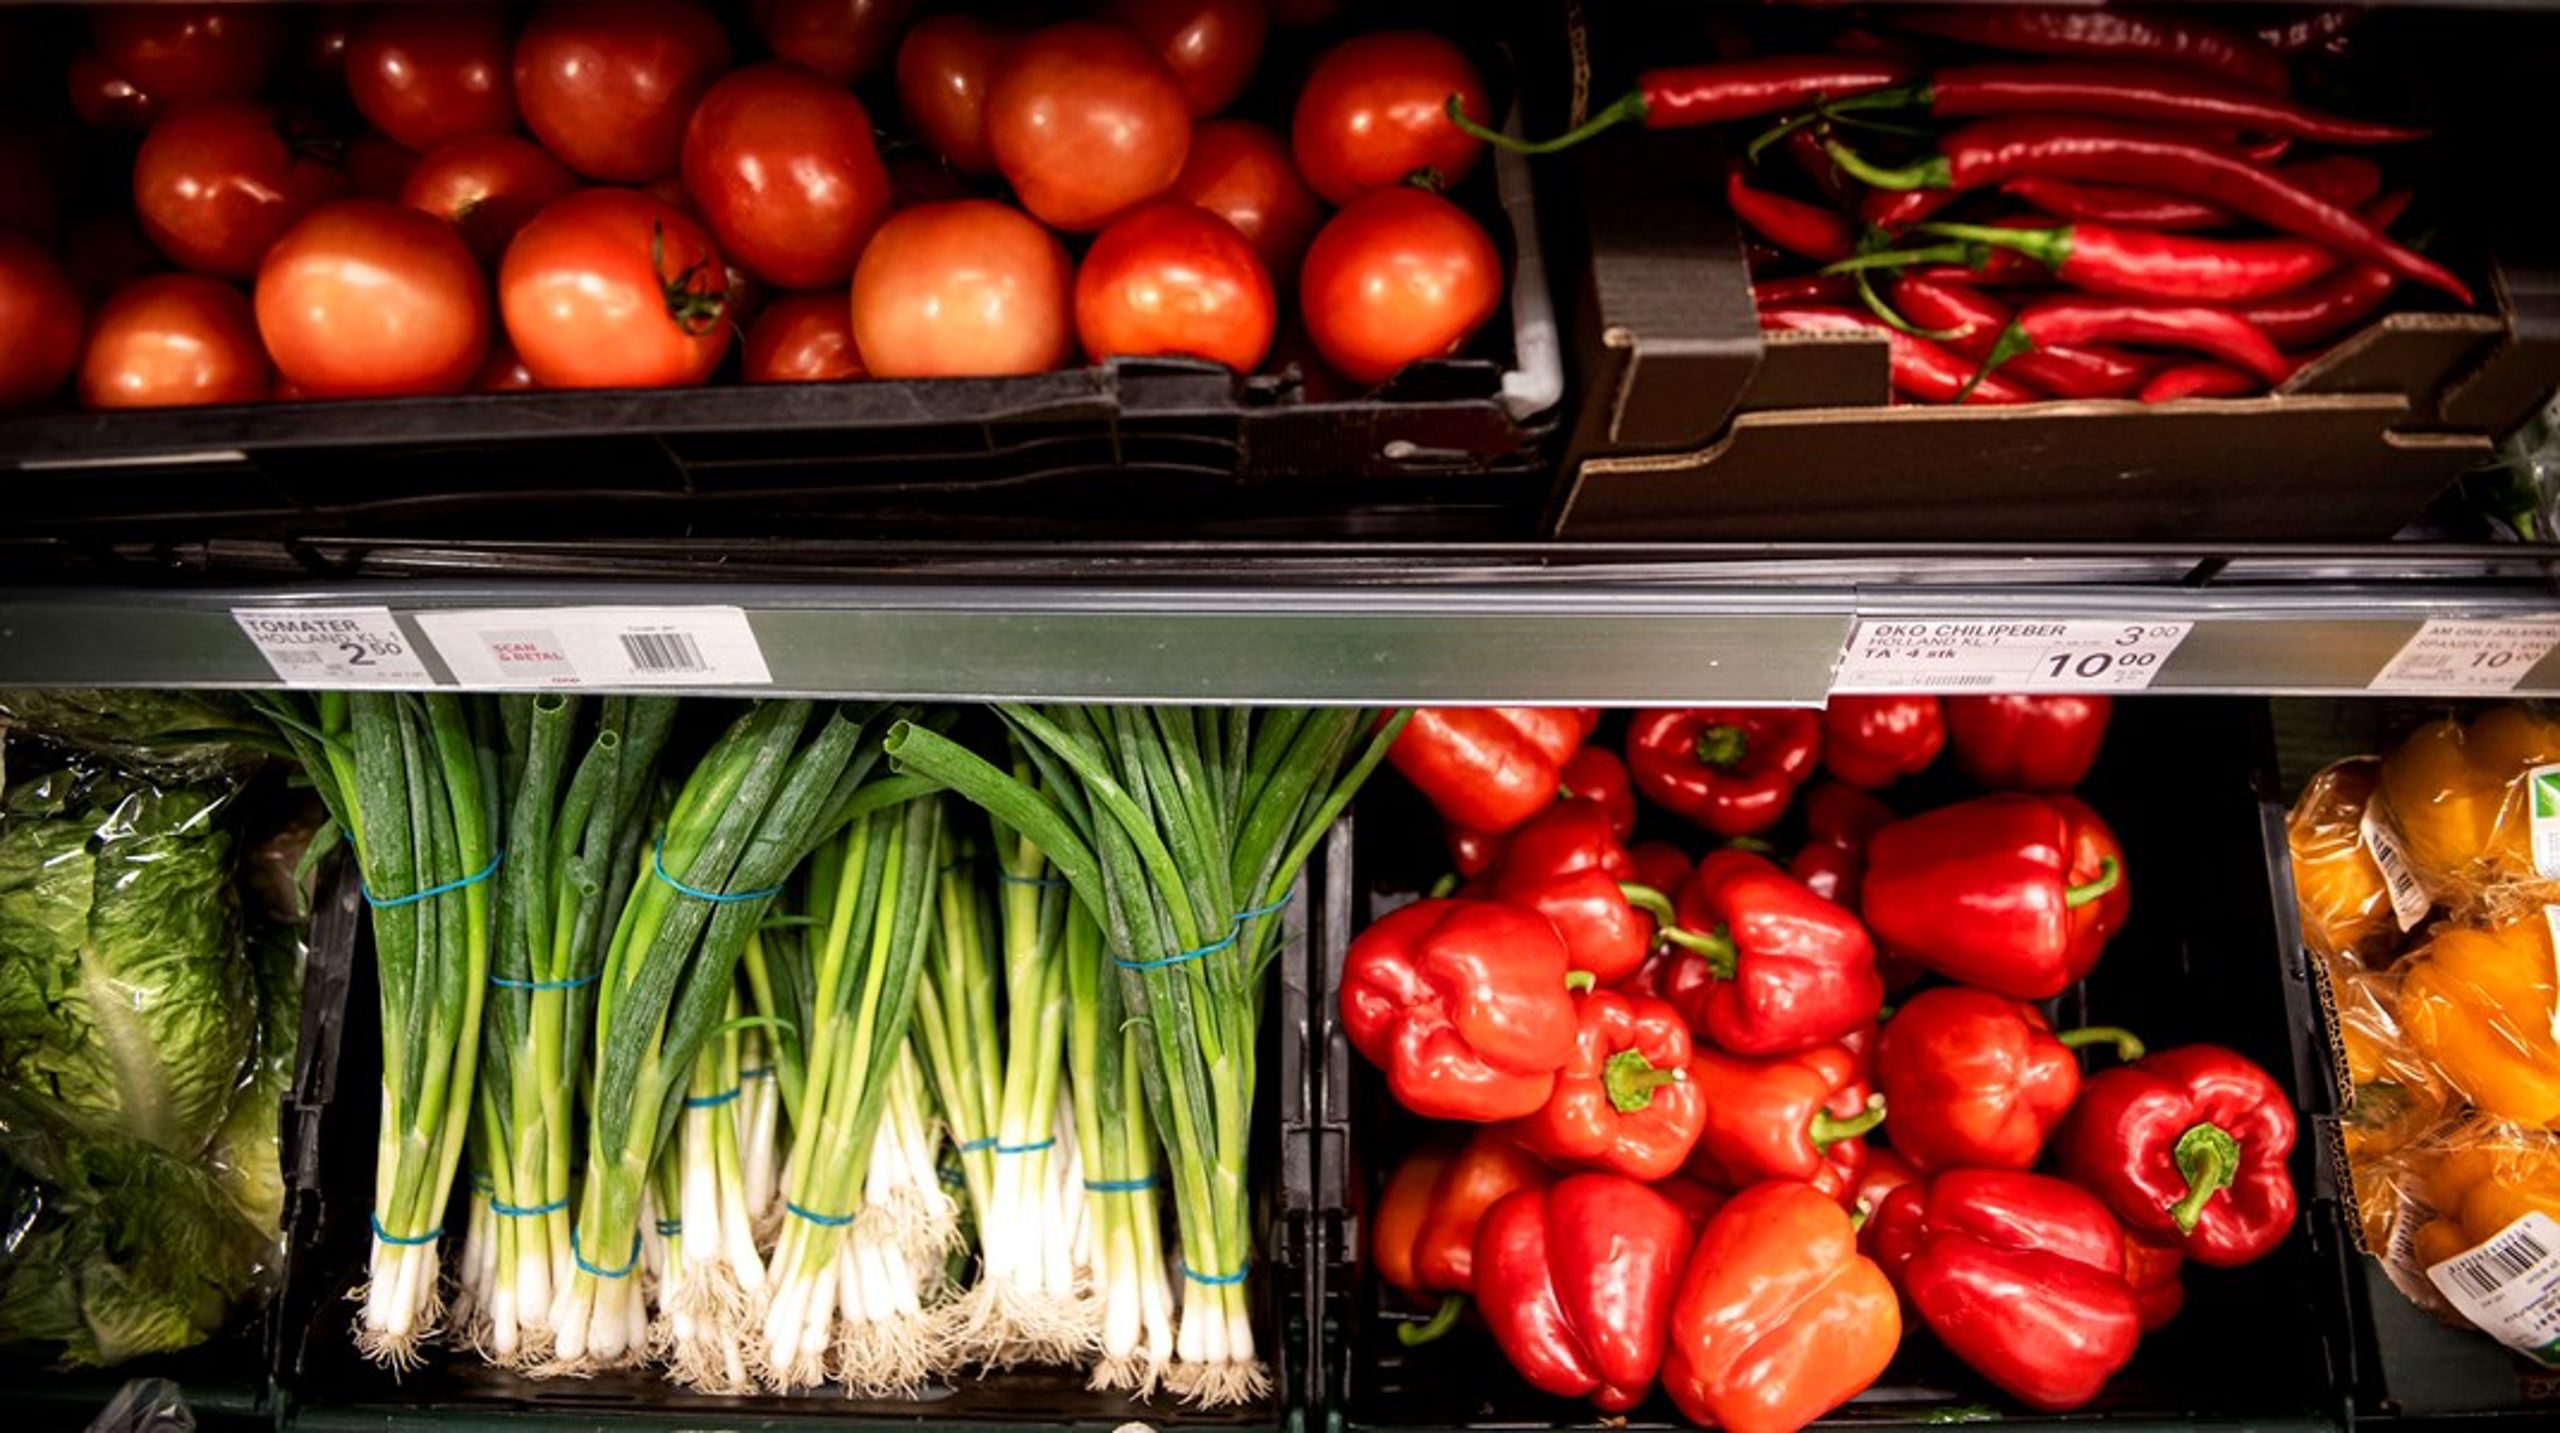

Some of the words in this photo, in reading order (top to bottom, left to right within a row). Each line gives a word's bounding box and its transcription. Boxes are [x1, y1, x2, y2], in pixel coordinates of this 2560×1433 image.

[247, 619, 360, 633] TOMATER
[1875, 624, 1927, 637] ØKO
[1934, 624, 2067, 637] CHILIPEBER
[255, 632, 351, 645] HOLLAND
[1869, 637, 1956, 647] HOLLAND
[2115, 626, 2144, 646] 3
[2150, 626, 2179, 638] 00
[493, 643, 536, 652] SCAN
[1906, 649, 1920, 659] 4
[1926, 648, 1957, 659] stk
[339, 643, 376, 666] 2
[371, 643, 403, 656] 50
[513, 652, 563, 661] BETAL
[2471, 651, 2513, 669] 10
[2049, 652, 2113, 678] 10
[2119, 652, 2156, 666] 00
